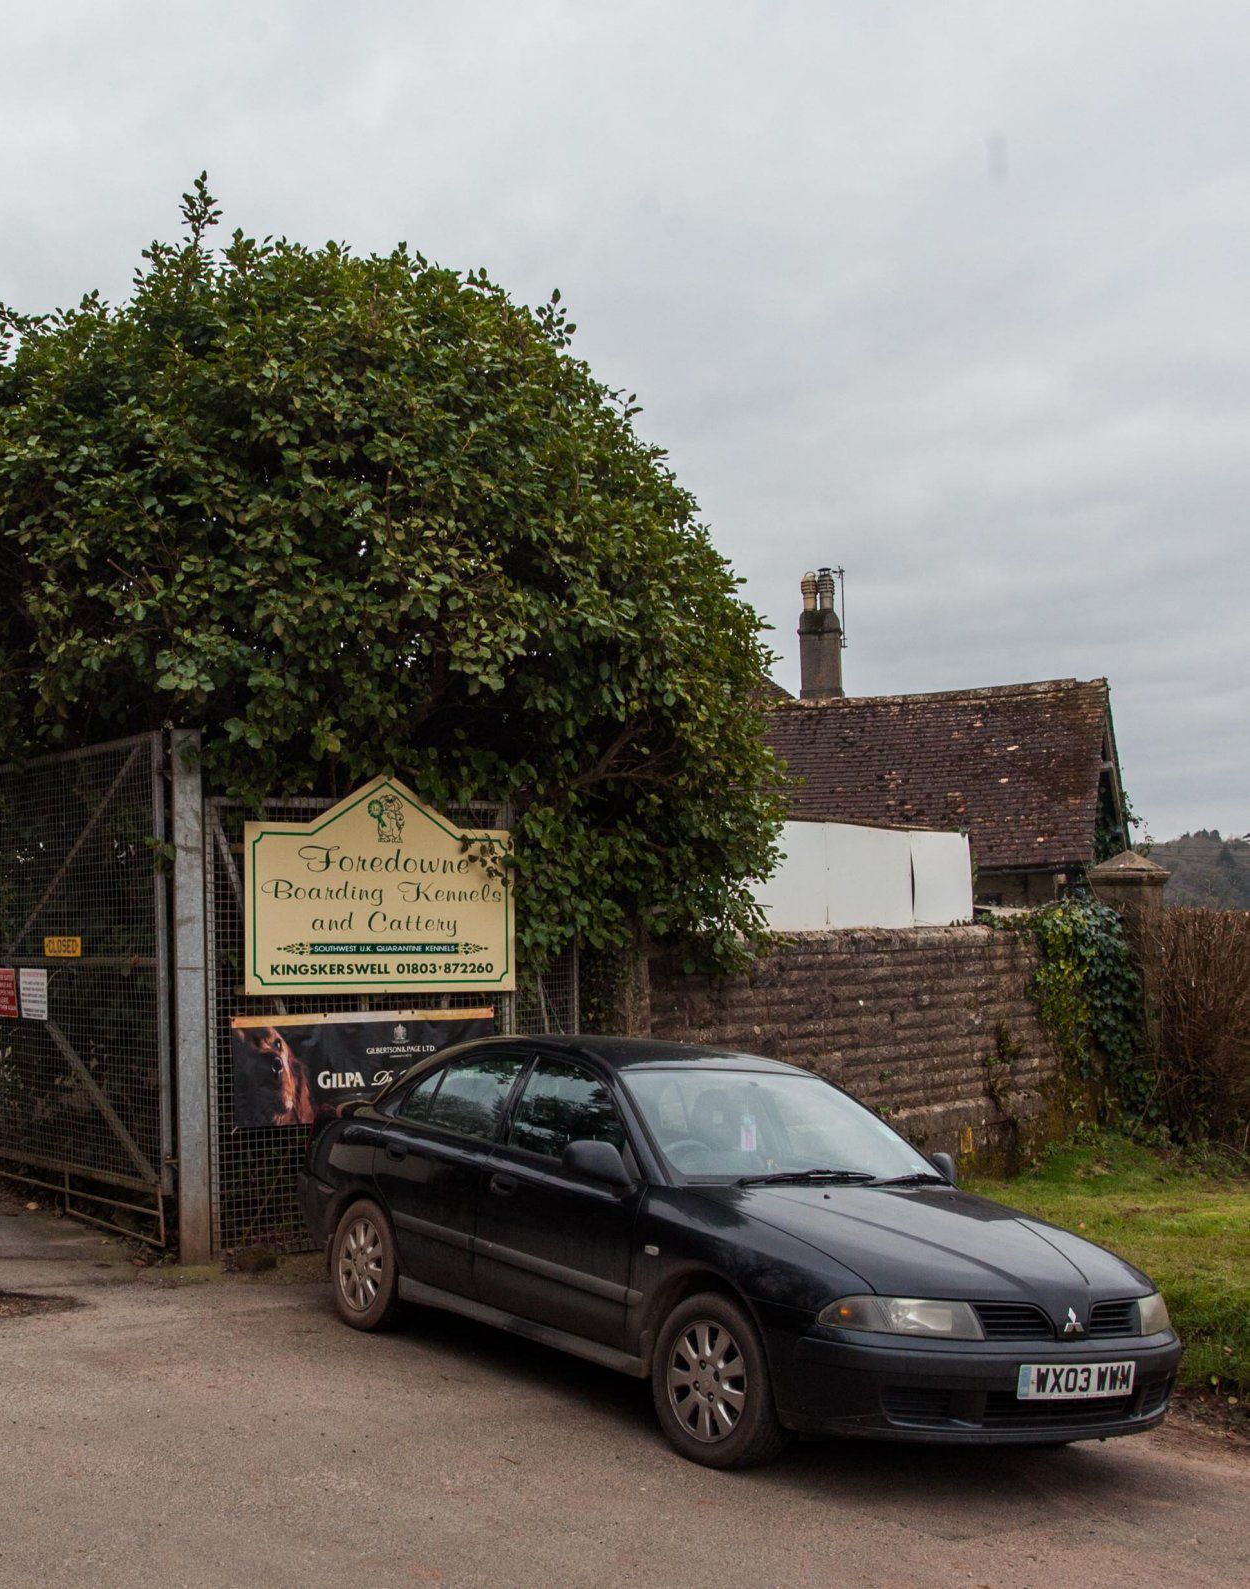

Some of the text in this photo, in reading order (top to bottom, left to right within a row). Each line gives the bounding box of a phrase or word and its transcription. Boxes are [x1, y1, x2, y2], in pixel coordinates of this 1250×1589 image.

[298, 845, 469, 874] Foredowne
[261, 878, 502, 907] Boarding Kennels
[311, 911, 458, 938] and Cattery
[48, 939, 77, 954] CLOSED
[313, 944, 456, 953] SOUTHWEST U.K. QUARANTINE KENNELS
[270, 963, 390, 976] KINGSKERSWELL
[422, 1045, 437, 1053] LTD.
[317, 1070, 366, 1090] GILPA
[1036, 1365, 1132, 1393] WX03 WWM
